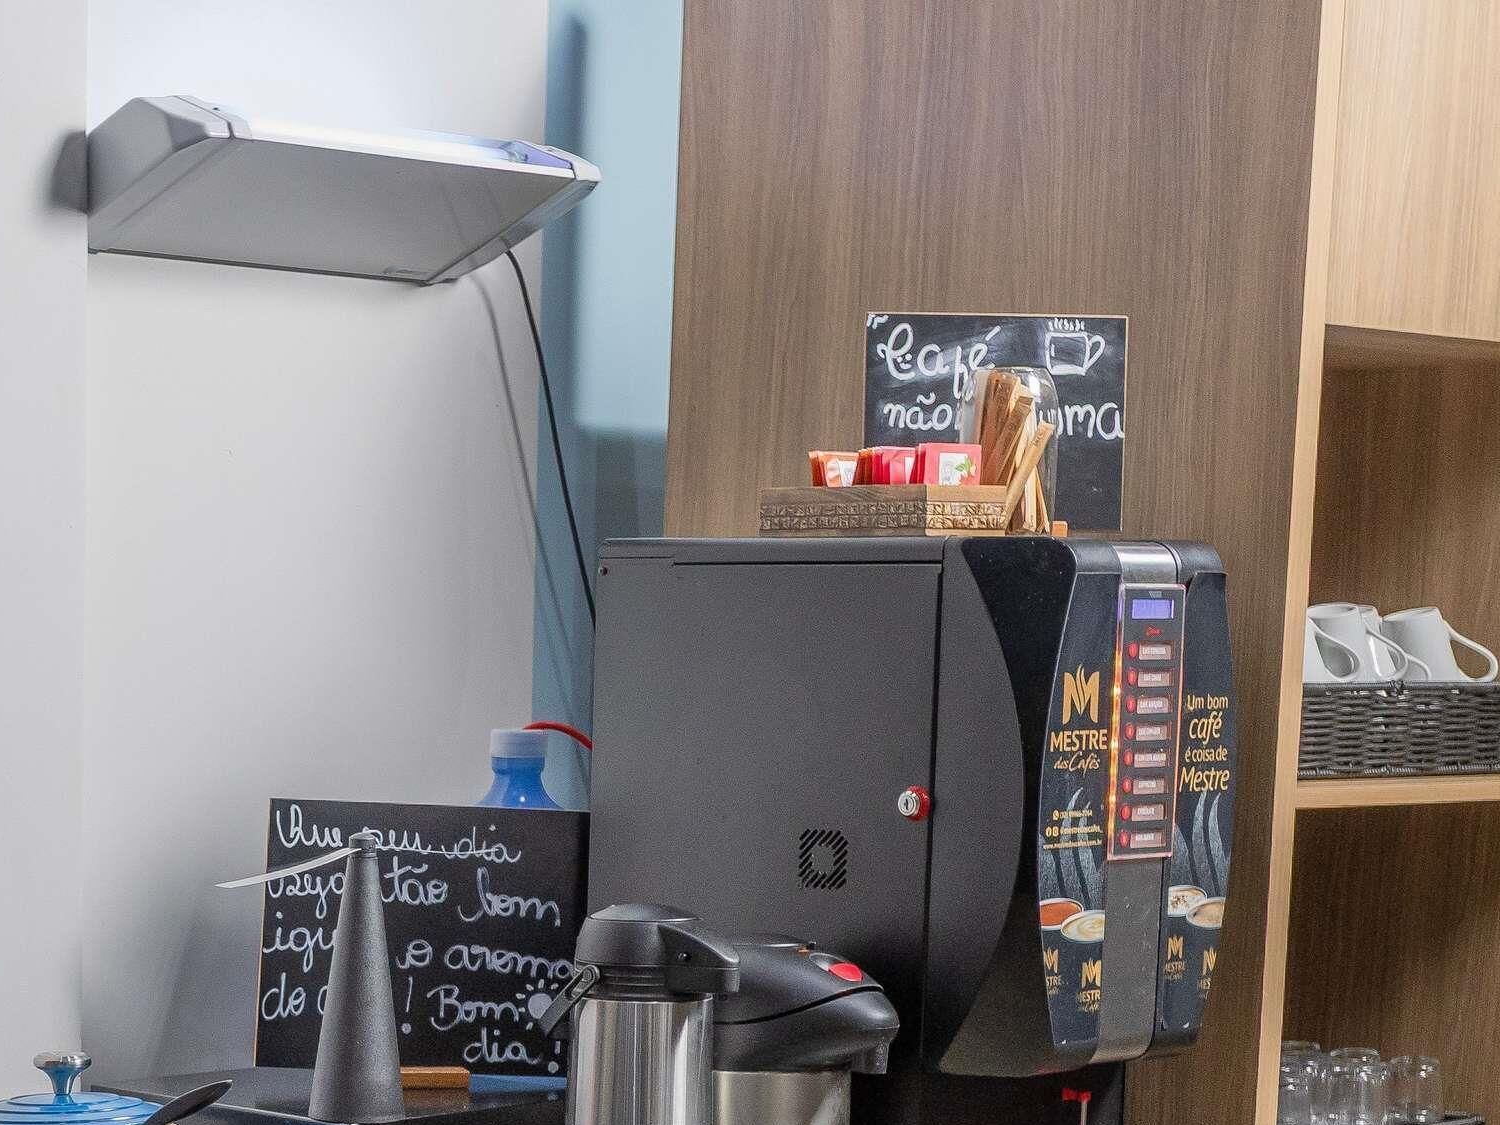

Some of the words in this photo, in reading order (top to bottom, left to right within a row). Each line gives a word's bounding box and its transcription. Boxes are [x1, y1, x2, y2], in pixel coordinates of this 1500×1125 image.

[877, 322, 1002, 402] Café
[883, 392, 954, 432] não
[1187, 694, 1204, 711] Um
[1207, 694, 1229, 710] bom
[1050, 729, 1108, 753] MESTRE
[1189, 710, 1222, 745] café
[1191, 747, 1215, 762] coisa
[1215, 745, 1228, 761] de
[1179, 766, 1230, 793] Mestre
[276, 803, 343, 848] Que
[440, 824, 522, 864] dia
[381, 855, 450, 907] tão
[458, 866, 562, 927] bom
[444, 943, 575, 981] aroma
[262, 972, 306, 1020] do
[427, 984, 521, 1030] Bom
